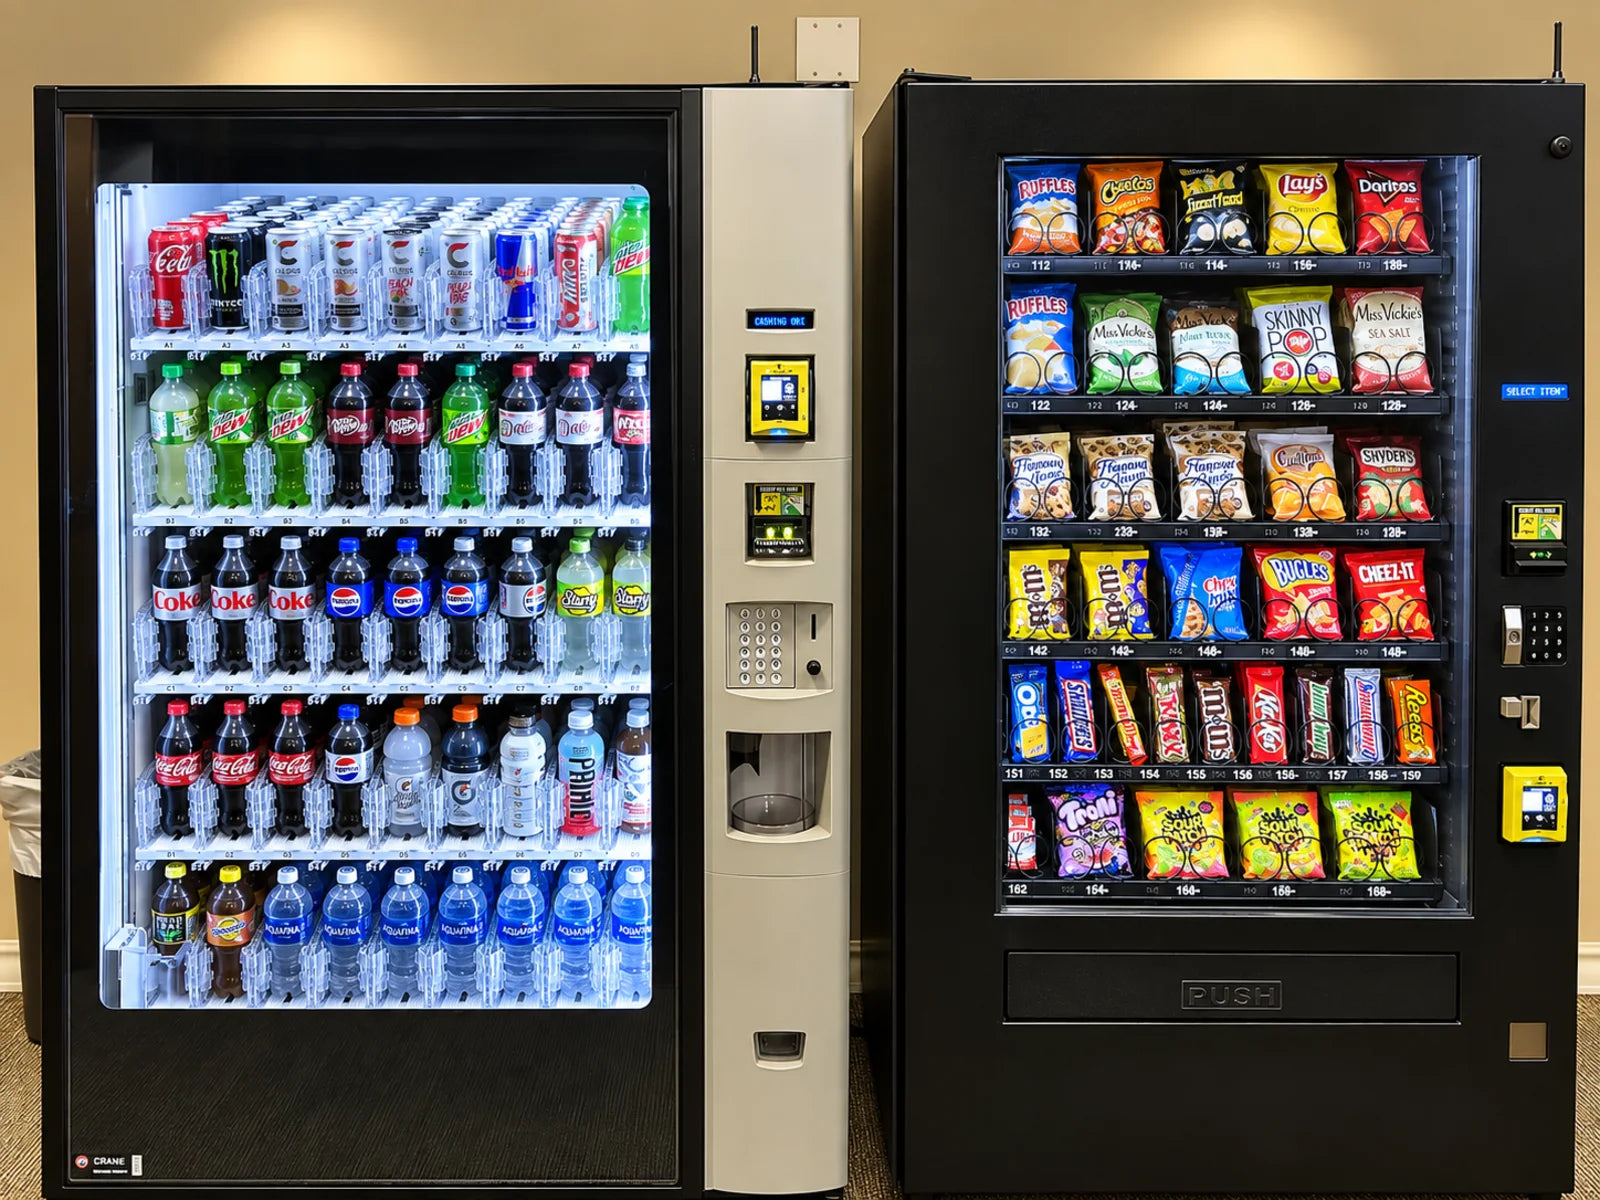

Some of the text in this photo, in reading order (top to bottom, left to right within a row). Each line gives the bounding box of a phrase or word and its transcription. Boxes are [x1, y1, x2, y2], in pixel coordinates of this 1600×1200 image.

[1018, 177, 1076, 200] RUFFLES
[1031, 260, 1051, 271] 112
[1007, 296, 1068, 320] RUFFLES
[1264, 305, 1322, 331] SKINNY
[1355, 302, 1422, 322] Miss Vickie's
[754, 316, 787, 326] CASHING
[1369, 327, 1411, 339] SEA SALT
[1506, 387, 1535, 396] SELECT
[1031, 400, 1051, 411] 122
[1269, 558, 1330, 586] BUGLES
[1358, 562, 1415, 583] CHEEZ-IT
[154, 590, 200, 611] Coke
[211, 590, 256, 611] Coke
[268, 589, 312, 610] Coke
[1058, 789, 1118, 831] Trolli
[1189, 986, 1275, 1006] PUSH
[93, 1157, 125, 1166] CRANE
